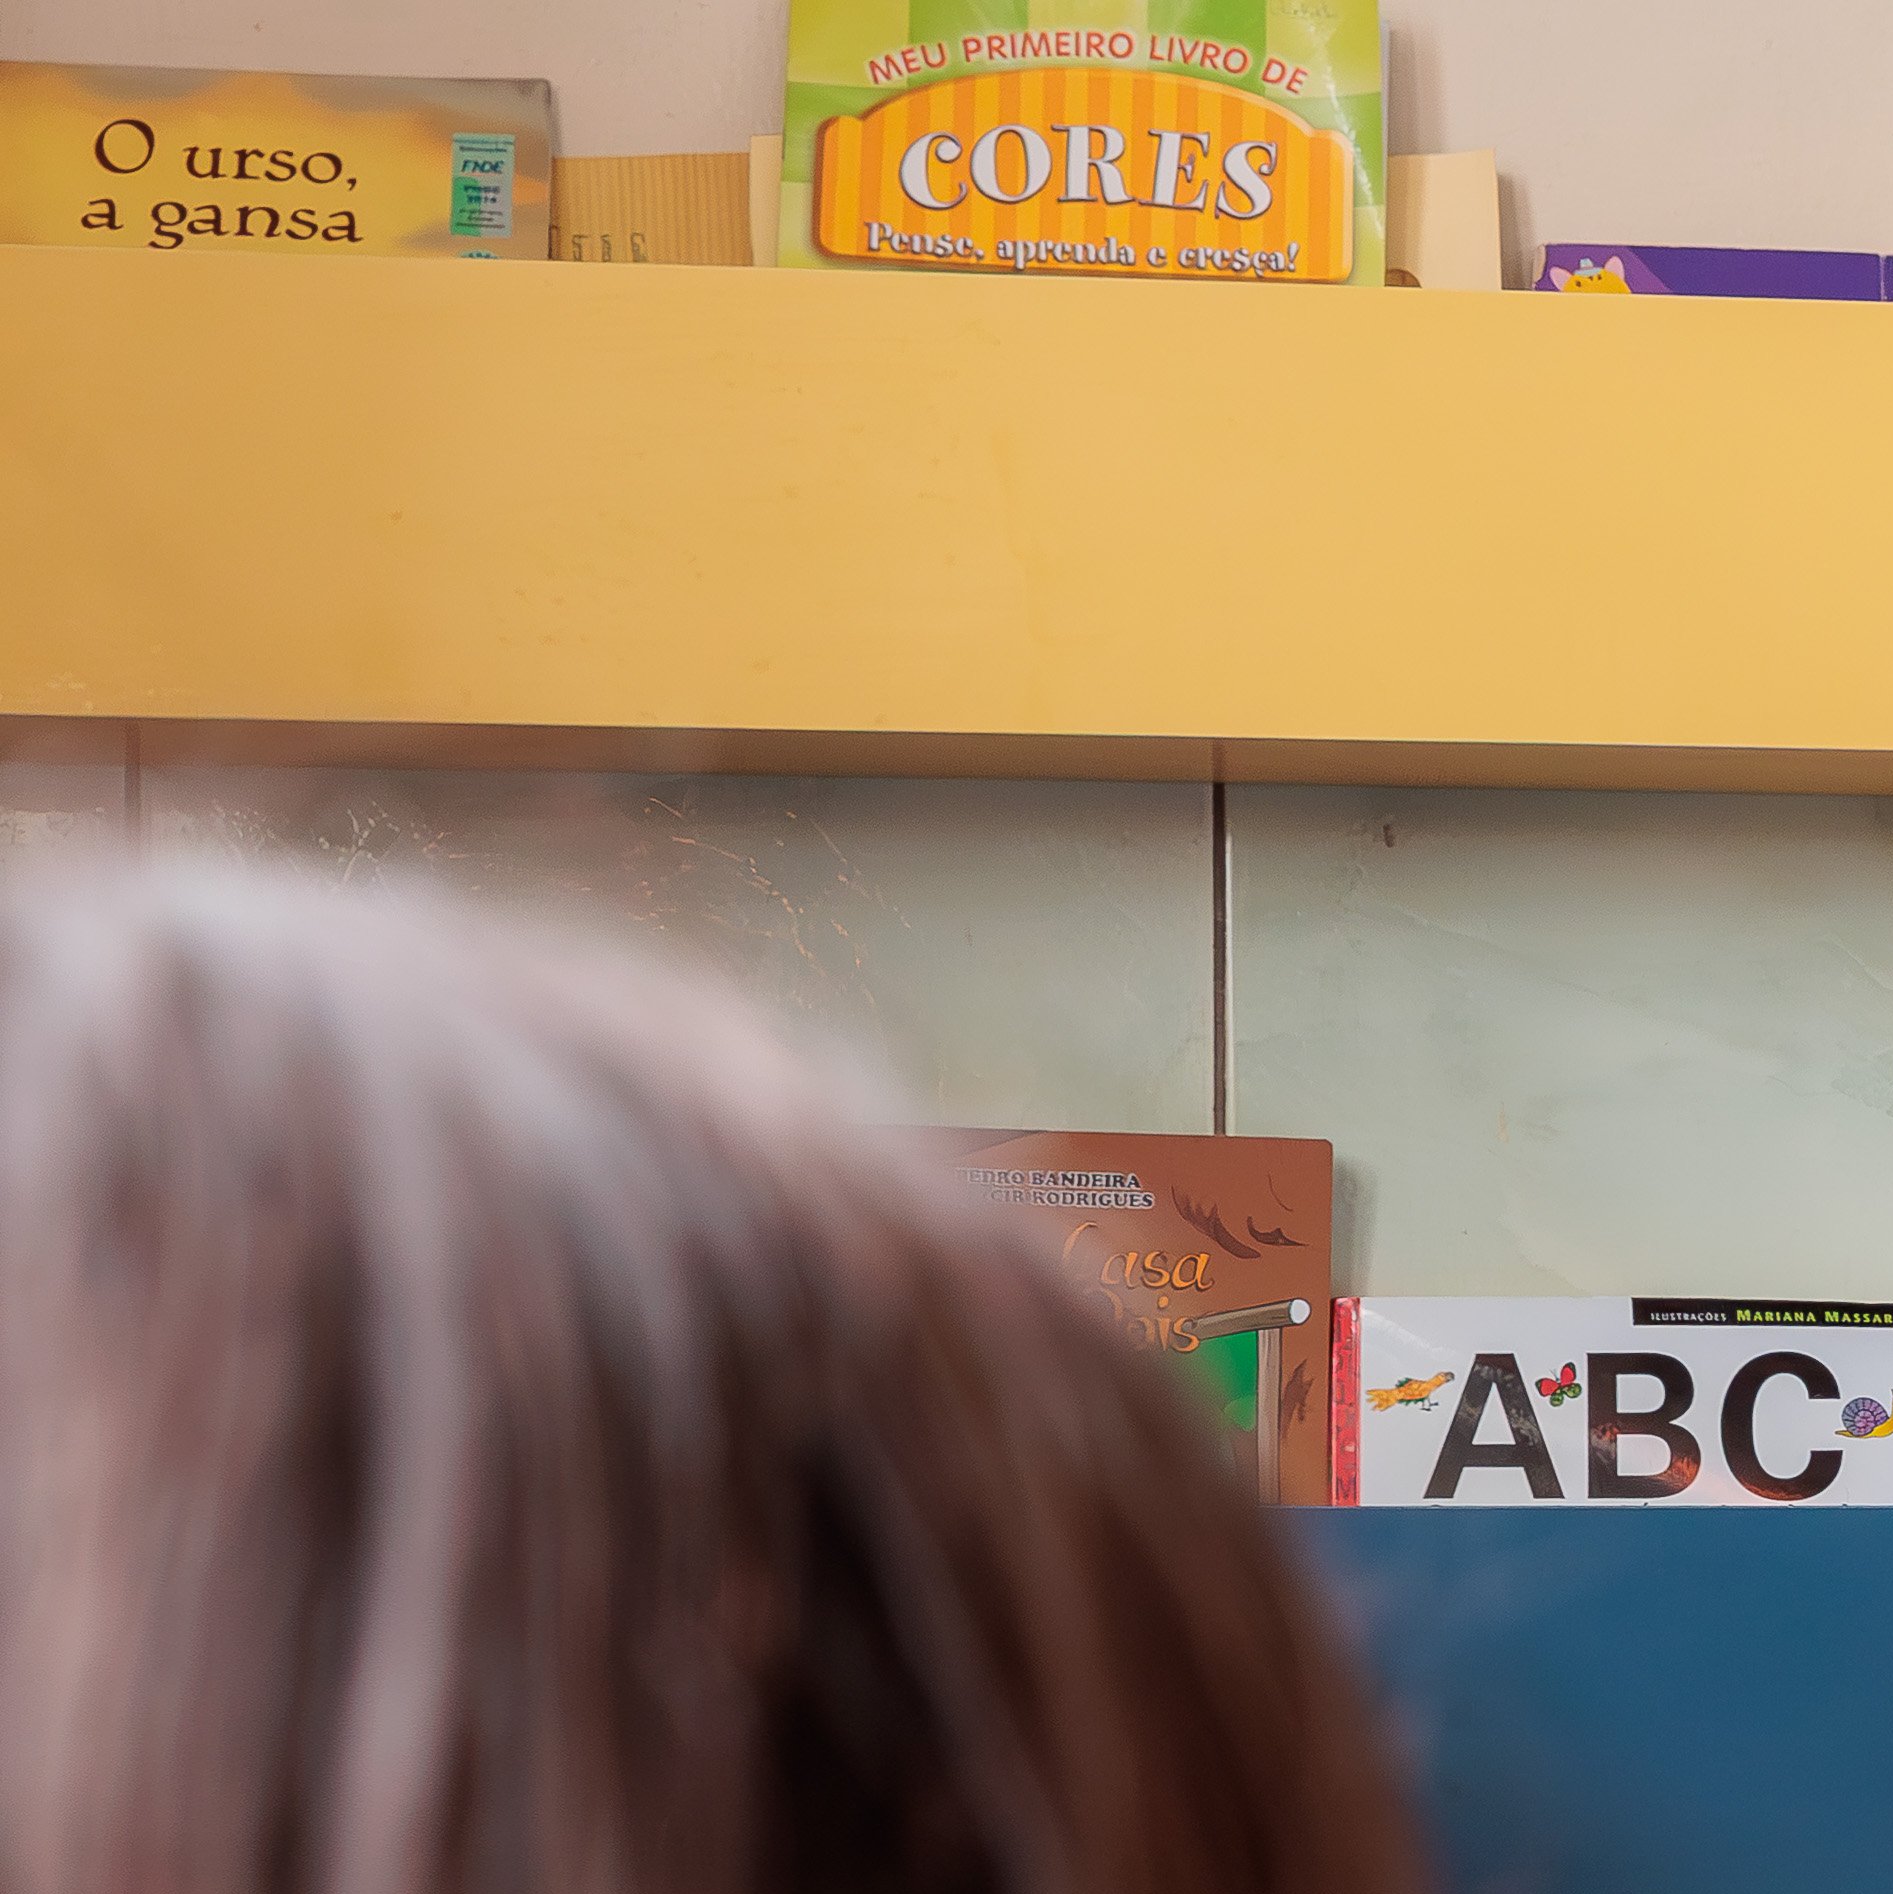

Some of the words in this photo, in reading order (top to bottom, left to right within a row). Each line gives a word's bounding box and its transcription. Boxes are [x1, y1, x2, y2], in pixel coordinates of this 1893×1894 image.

[868, 42, 947, 84] MEU
[962, 31, 1134, 63] PRIMEIRO
[1149, 35, 1249, 74] LIVRO
[1261, 57, 1309, 94] DE
[94, 118, 155, 174] O
[182, 146, 357, 191] urso,
[898, 124, 1278, 219] CORES
[81, 198, 124, 230] a
[148, 201, 364, 249] gansa
[864, 221, 985, 260] Pense,
[996, 235, 1136, 270] aprenda
[1147, 246, 1168, 267] e
[1178, 241, 1300, 278] cresça!
[1031, 1171, 1142, 1188] BANDEIRA
[1032, 1191, 1154, 1208] RODRIGUES
[1650, 1311, 1727, 1323] ILUSTRAÇÕES
[1736, 1310, 1816, 1323] MARIANA
[1423, 1351, 1844, 1501] ABC
